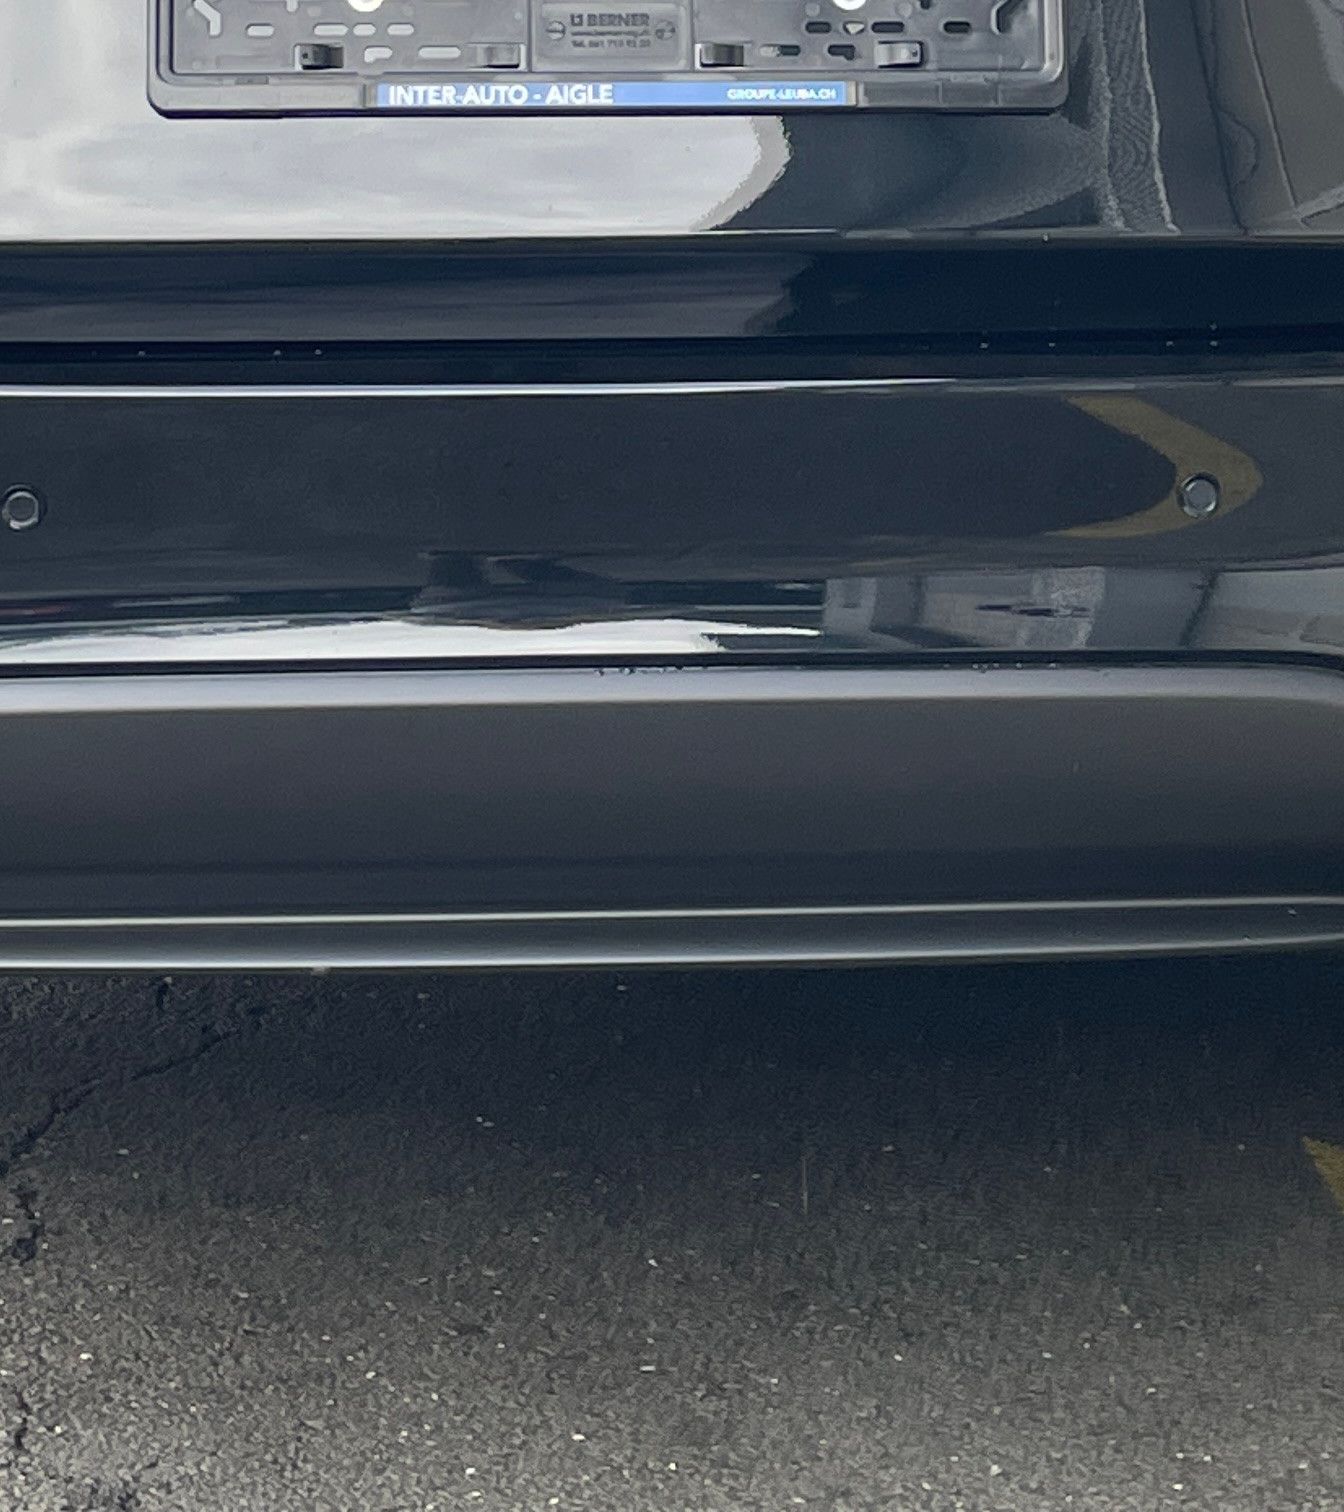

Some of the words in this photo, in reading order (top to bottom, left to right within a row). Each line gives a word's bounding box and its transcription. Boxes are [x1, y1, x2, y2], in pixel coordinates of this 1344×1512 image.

[587, 13, 650, 27] BERNER
[388, 83, 530, 105] INTER-AUTO
[545, 83, 614, 104] AIGLE
